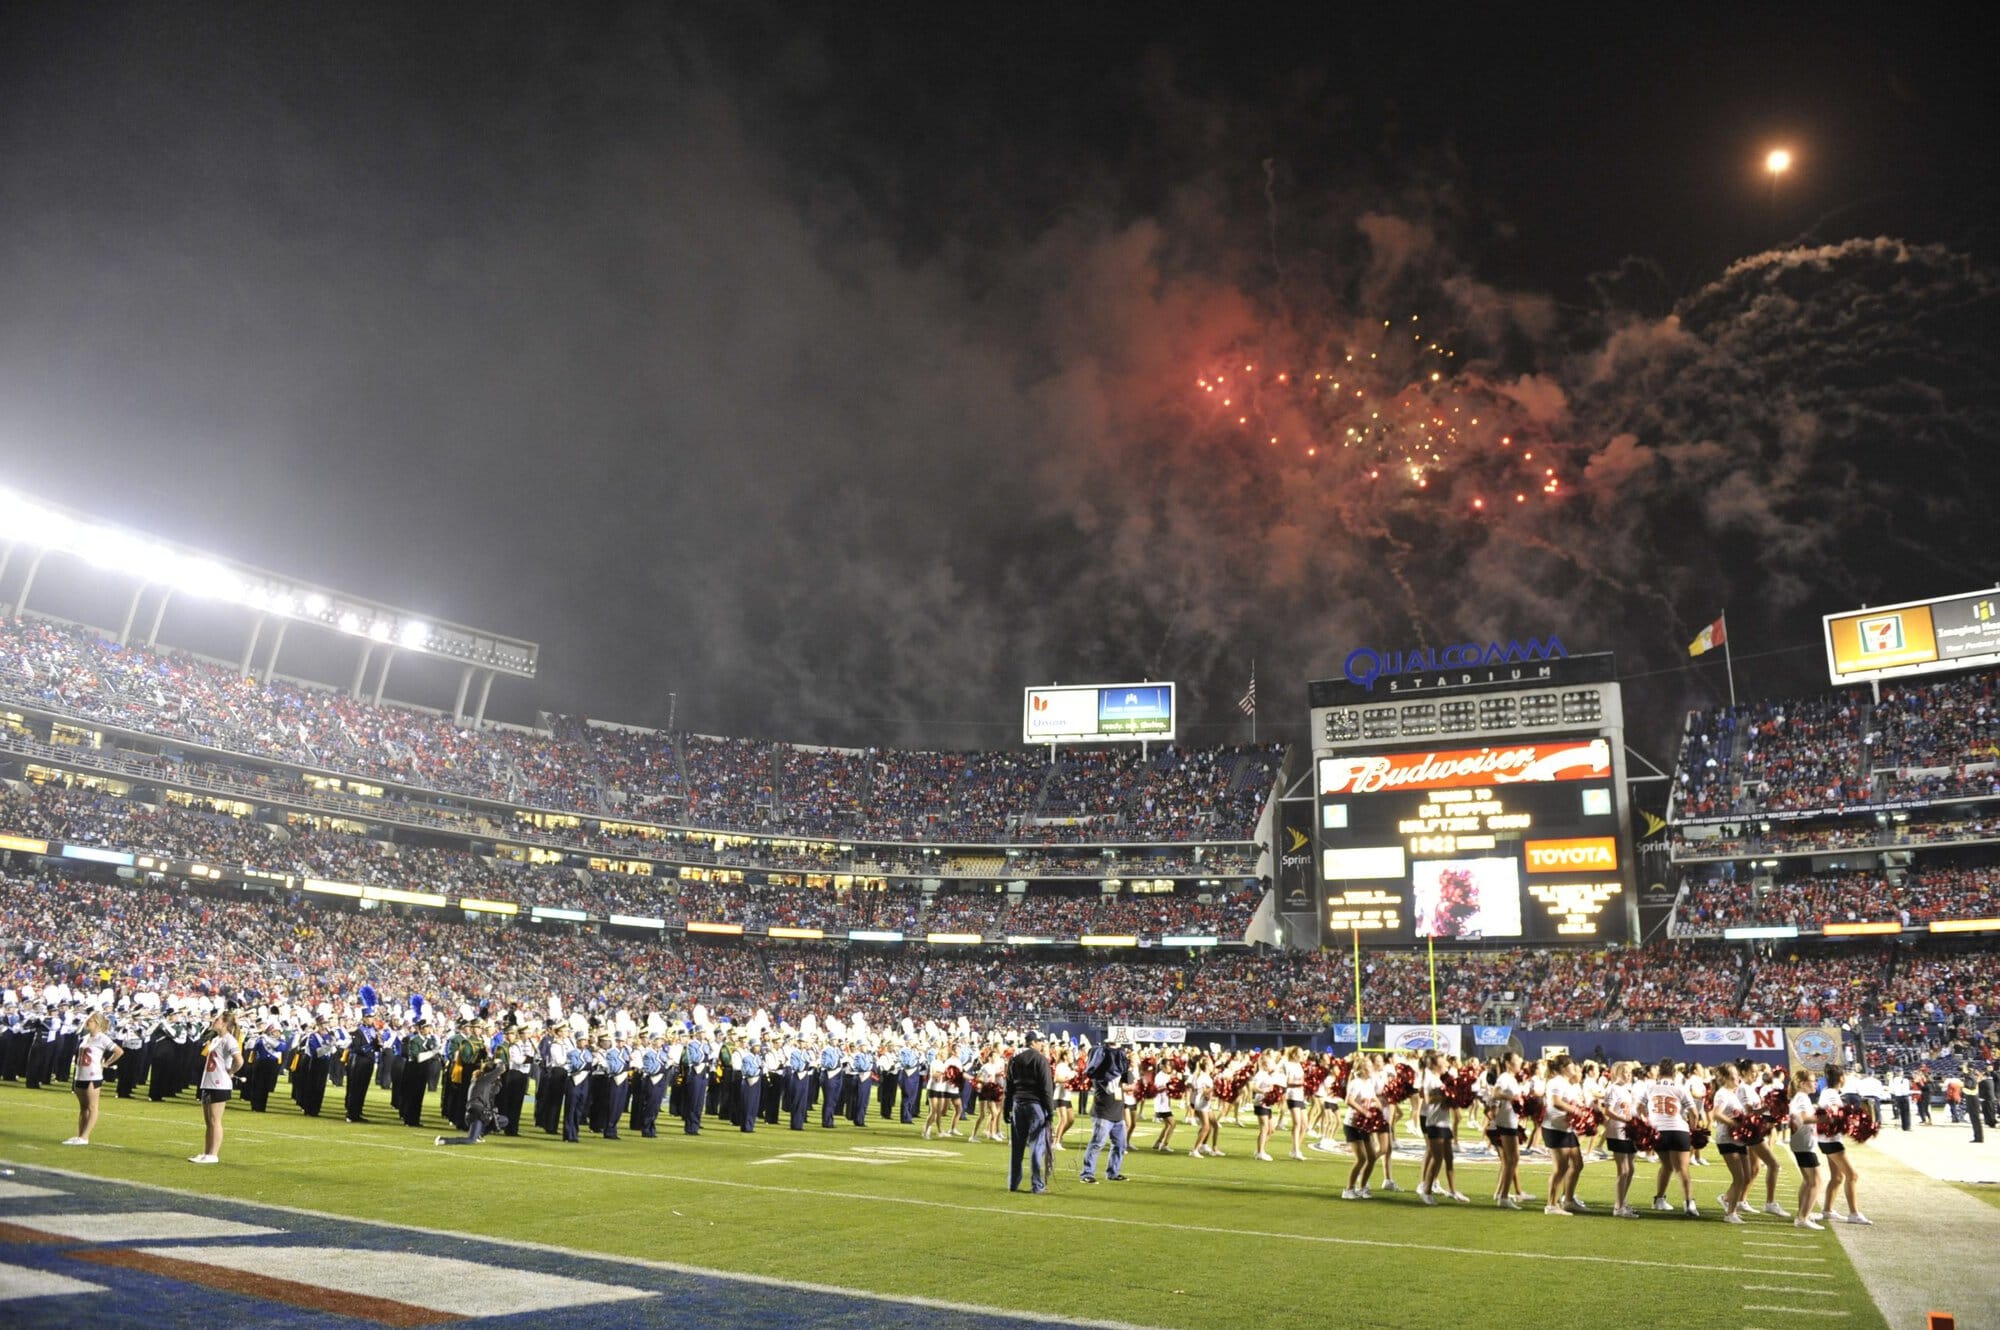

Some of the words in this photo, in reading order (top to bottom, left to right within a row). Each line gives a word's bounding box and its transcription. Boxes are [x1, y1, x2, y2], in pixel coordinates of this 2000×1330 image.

[1344, 636, 1568, 691] QUALCOMM
[1391, 667, 1551, 691] STADIUM
[1349, 748, 1536, 793] Budweiser
[1282, 854, 1312, 867] Sprint
[1530, 846, 1612, 865] TOYOTA
[1753, 1030, 1775, 1048] N
